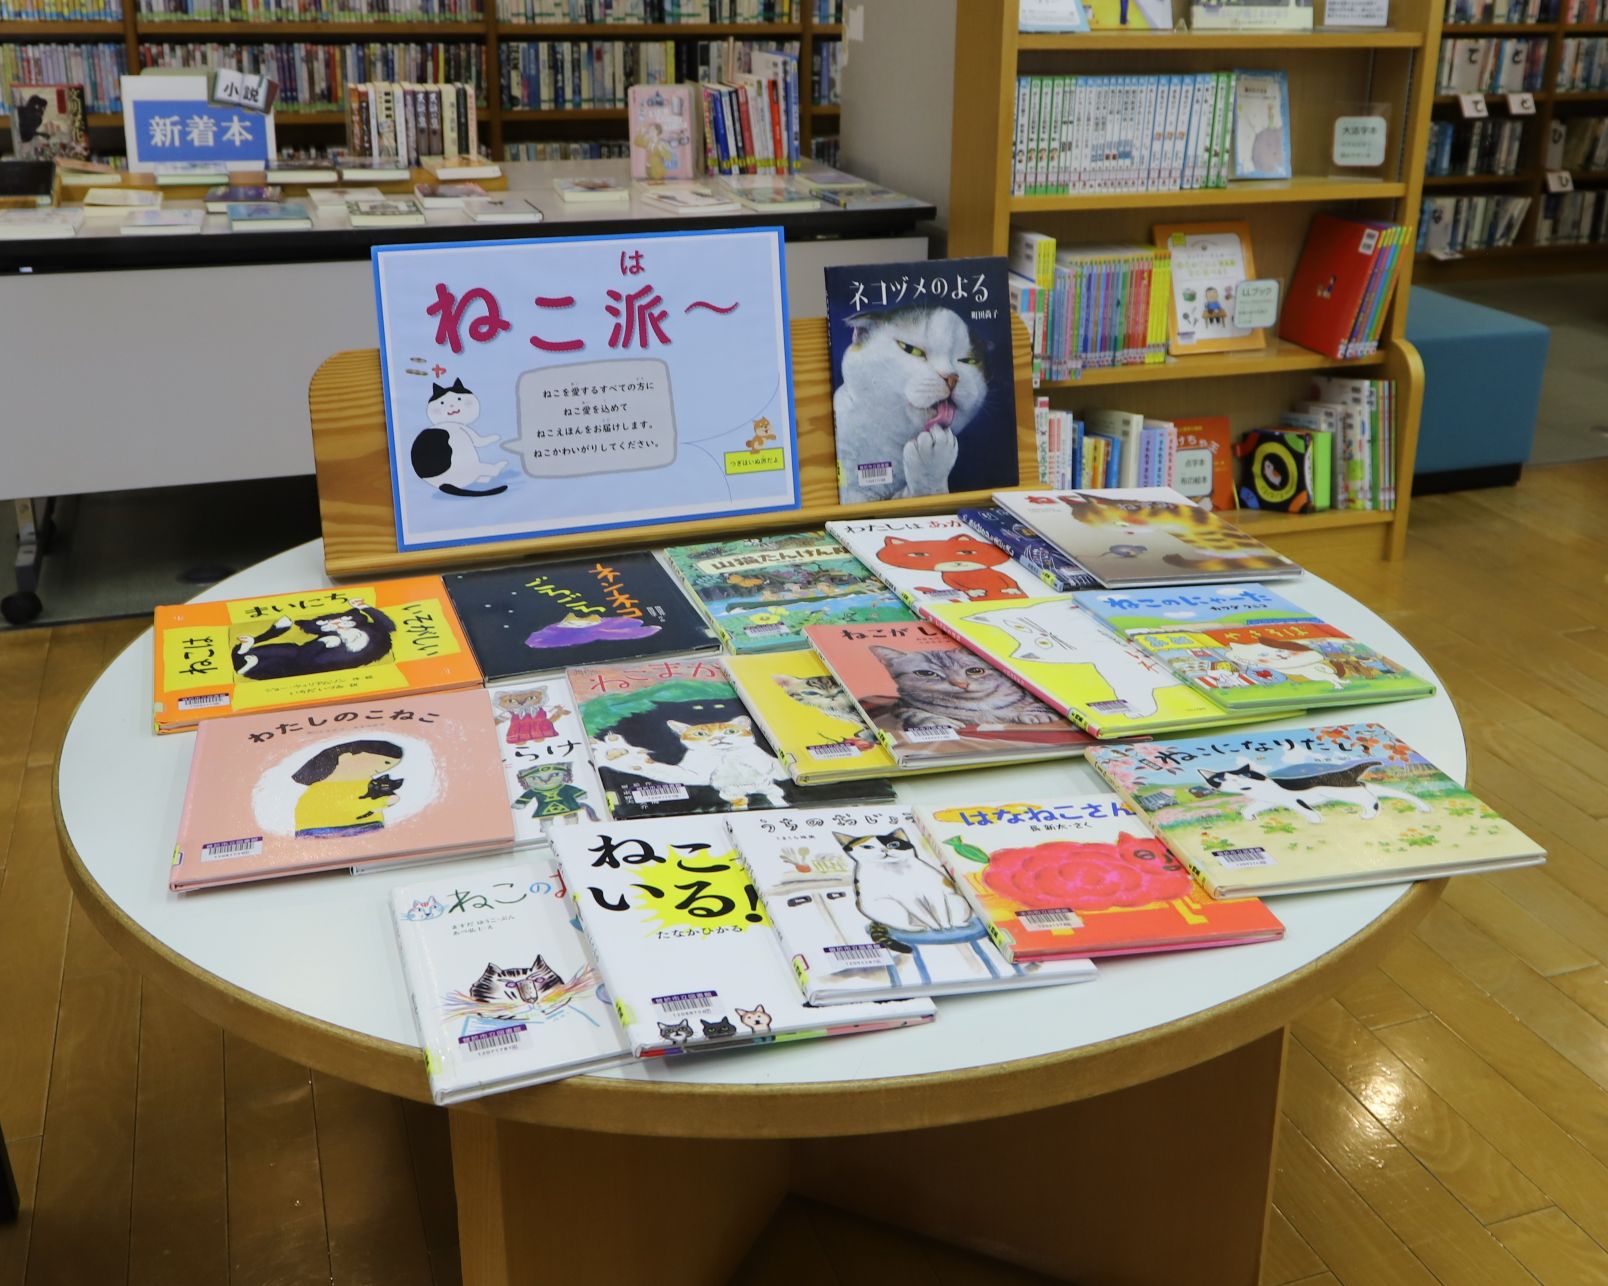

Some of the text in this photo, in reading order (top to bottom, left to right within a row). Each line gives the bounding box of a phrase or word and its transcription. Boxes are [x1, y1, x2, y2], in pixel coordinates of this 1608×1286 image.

[224, 82, 259, 103] 小説
[149, 115, 253, 147] 新着本
[620, 250, 644, 276] は
[849, 273, 989, 312] ネコヅメのよる
[543, 382, 655, 399] ねこを愛するすべての方に
[563, 403, 628, 416] ねこ愛を込めて
[536, 420, 653, 439] ねこえほんをお届けします。
[533, 440, 660, 458] ねこかわいがりしてください。
[244, 592, 348, 618] まいにち
[401, 603, 440, 656] いそがしい
[842, 627, 909, 641] ねこが
[178, 635, 218, 676] ねこは
[248, 709, 441, 744] わたしのこねこ
[1154, 737, 1372, 765] ねこになりたい
[959, 802, 1137, 827] はなねこさん
[588, 834, 731, 873] ねこ
[657, 925, 743, 939] たなかひかる
